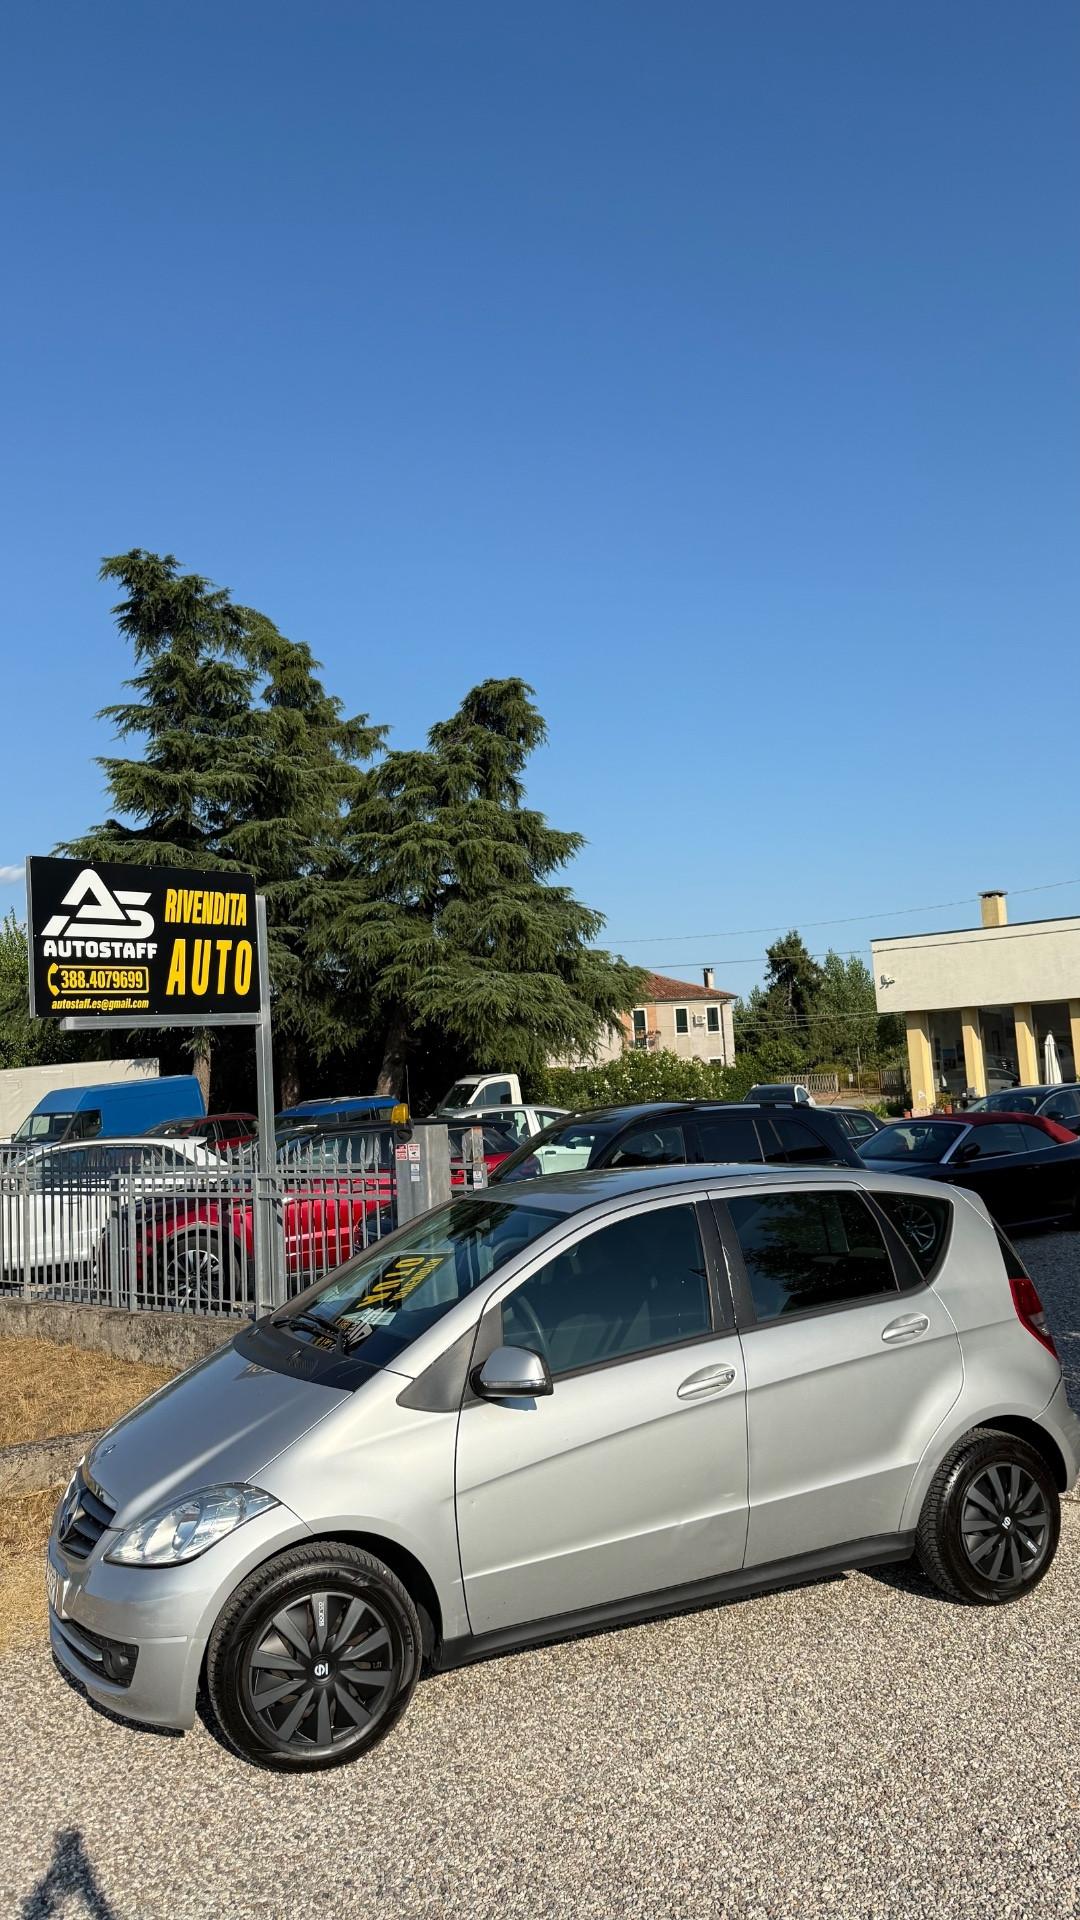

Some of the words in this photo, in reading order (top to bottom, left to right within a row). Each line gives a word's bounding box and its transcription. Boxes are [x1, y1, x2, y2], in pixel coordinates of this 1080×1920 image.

[165, 888, 247, 926] RIVENDITA
[43, 940, 158, 959] AUTOSTAFF
[166, 938, 253, 996] AUTO
[60, 970, 143, 988] 388.4079699
[51, 998, 149, 1010] autostaff.es@gmail.com
